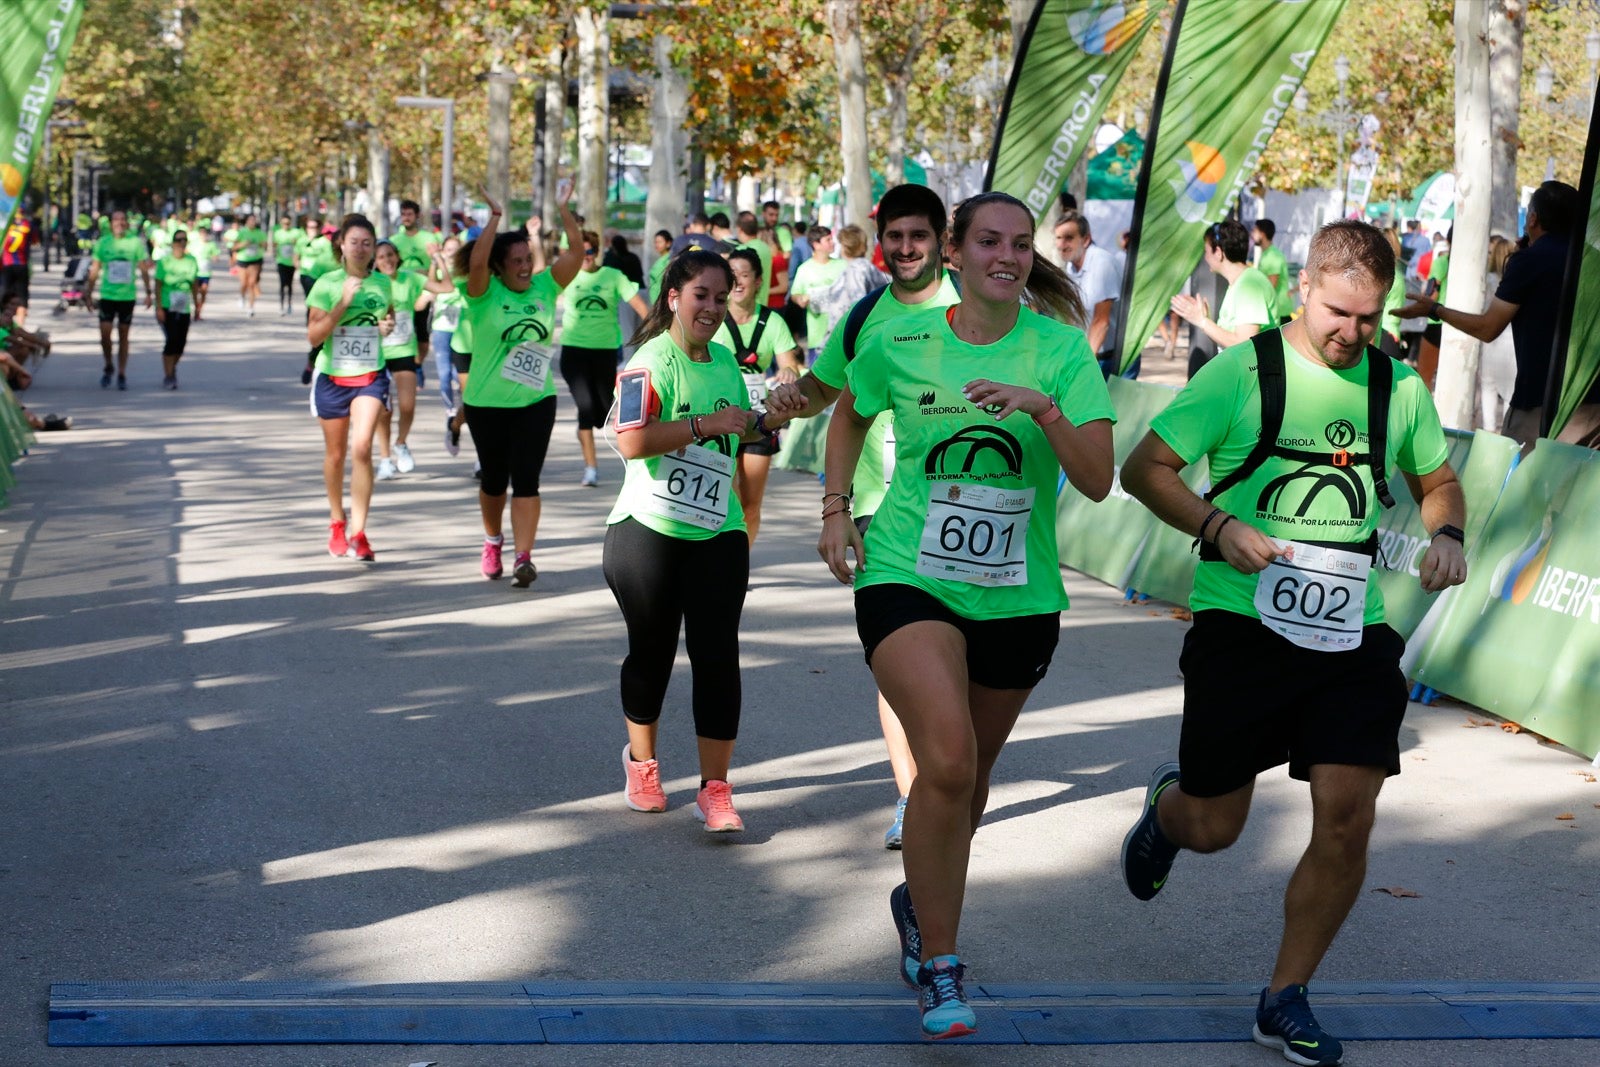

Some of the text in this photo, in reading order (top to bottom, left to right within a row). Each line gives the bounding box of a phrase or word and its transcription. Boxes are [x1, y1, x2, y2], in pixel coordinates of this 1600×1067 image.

[894, 334, 921, 342] luanvi
[340, 340, 371, 357] 364
[512, 351, 543, 375] 588
[921, 406, 968, 415] IBERDROLA
[1277, 438, 1316, 447] RDROLA
[667, 467, 721, 507] 614
[1266, 513, 1296, 524] FORMA
[1301, 518, 1317, 526] POR
[1317, 518, 1327, 526] LA
[1328, 519, 1363, 527] IGUALDAD
[940, 515, 1015, 558] 601
[1272, 576, 1351, 624] 602
